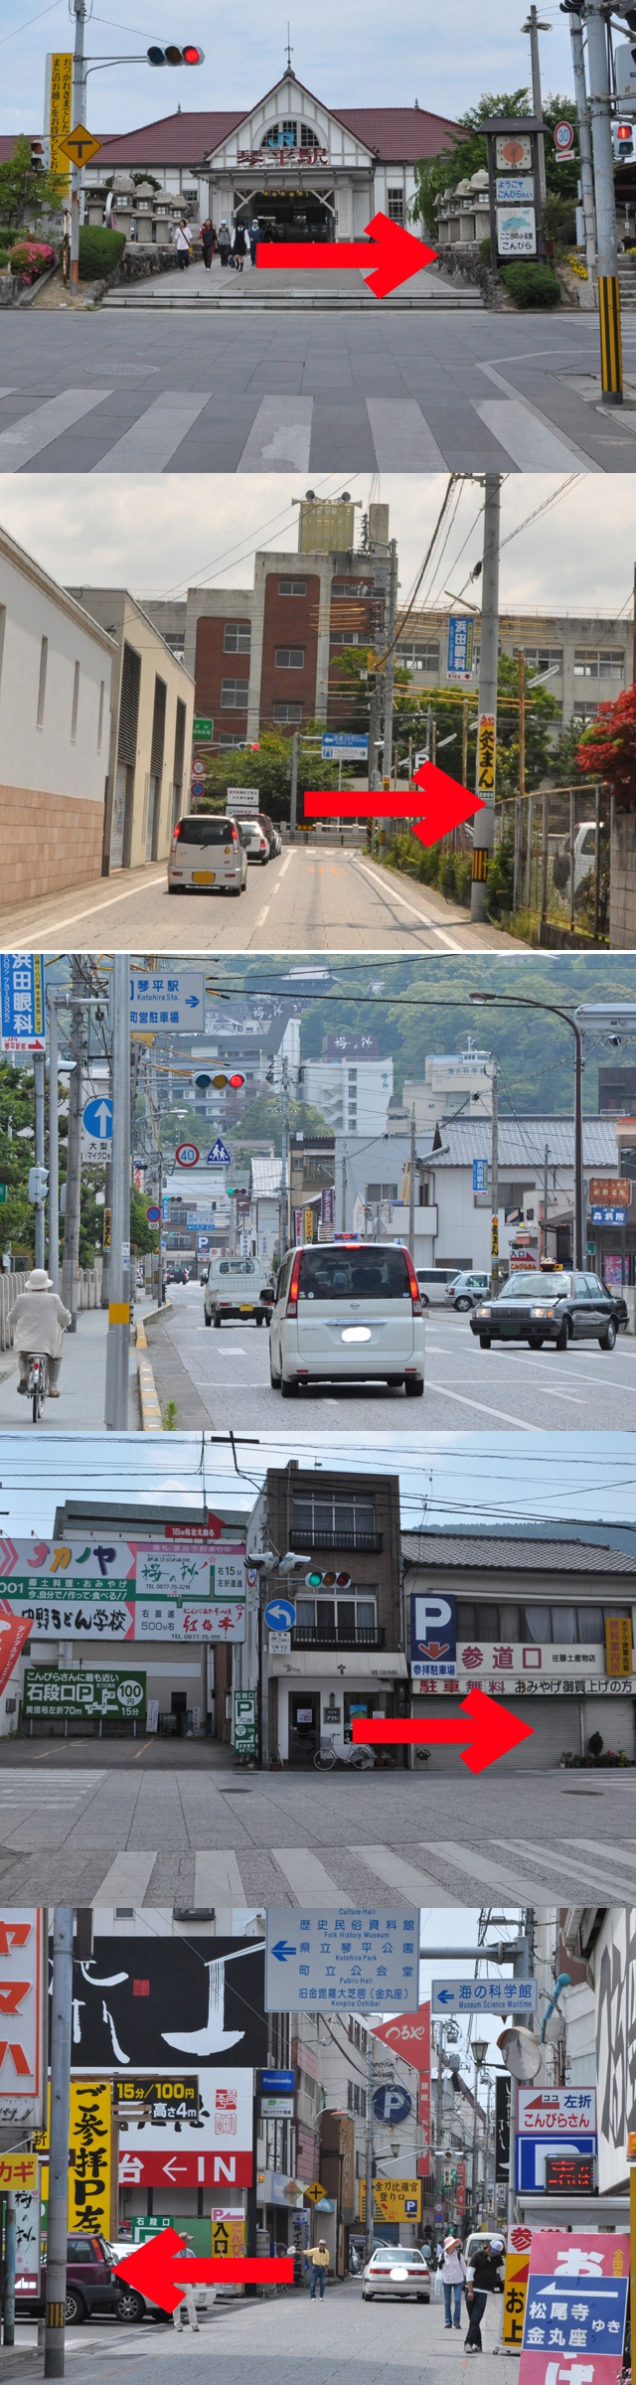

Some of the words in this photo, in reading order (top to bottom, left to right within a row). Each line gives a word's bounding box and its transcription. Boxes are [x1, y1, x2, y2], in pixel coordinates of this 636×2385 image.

[62, 58, 72, 132] おつかれさまでした
[267, 132, 295, 147] JR
[558, 129, 569, 142] 30
[237, 148, 328, 166] 琴平駅
[502, 241, 532, 250] こんぴら
[478, 729, 495, 788] 灸まん
[138, 980, 179, 992] 琴平駅
[12, 954, 33, 1034] 浜田眼科
[130, 1011, 180, 1024] 町営駐車場
[180, 1150, 195, 1162] 40
[198, 1237, 209, 1249] P
[27, 1541, 116, 1576] ナカノヤ
[28, 1578, 127, 1588] 郷土料理・おみやげ
[217, 1579, 243, 1588] 左折直進
[22, 1607, 127, 1632] 中野うどん学校
[142, 1609, 175, 1618] 右直進
[415, 1597, 452, 1641] P
[609, 1620, 619, 1673] 無料案内所
[462, 1646, 542, 1669] 参道口
[552, 1654, 596, 1662] 佐藤土産物店
[27, 1672, 119, 1682] こんぴらさんに最も近い
[413, 1665, 455, 1676] 参拝駐車場
[27, 1684, 75, 1701] 石段口
[119, 1685, 141, 1698] 100
[420, 1680, 505, 1693] 駐車無料
[515, 1680, 632, 1693] おみやげ御買上げの方
[26, 1706, 82, 1715] 黄信号左折70m
[121, 1707, 139, 1715] 15分
[237, 1701, 253, 1717] P
[300, 1919, 415, 1931] 歴史民俗資料館
[300, 1942, 414, 1954] 県立琴平公園
[299, 1965, 413, 1977] 町立公会堂
[459, 1984, 533, 1999] 海の科学館
[385, 2025, 425, 2041] つるや
[117, 2083, 195, 2099] 15分/100円
[421, 2082, 429, 2101] 旅館
[384, 2091, 405, 2118] P
[564, 2095, 592, 2108] 左折
[153, 2102, 197, 2118] 高さ4m
[524, 2113, 590, 2128] こんぴらさん
[73, 2084, 108, 2241] ご参拝P左
[118, 2153, 145, 2183] 台
[198, 2156, 236, 2182] IN
[0, 2164, 34, 2182] カギ
[375, 2181, 419, 2192] 金刀比羅宮
[380, 2193, 405, 2201] 登り口
[406, 2201, 416, 2211] P
[136, 2217, 170, 2226] 石段口
[212, 2209, 224, 2220] P
[213, 2222, 229, 2254] 入口
[529, 2301, 589, 2322] 松尾寺
[592, 2320, 621, 2334] ゆき
[527, 2326, 588, 2347] 金丸座
